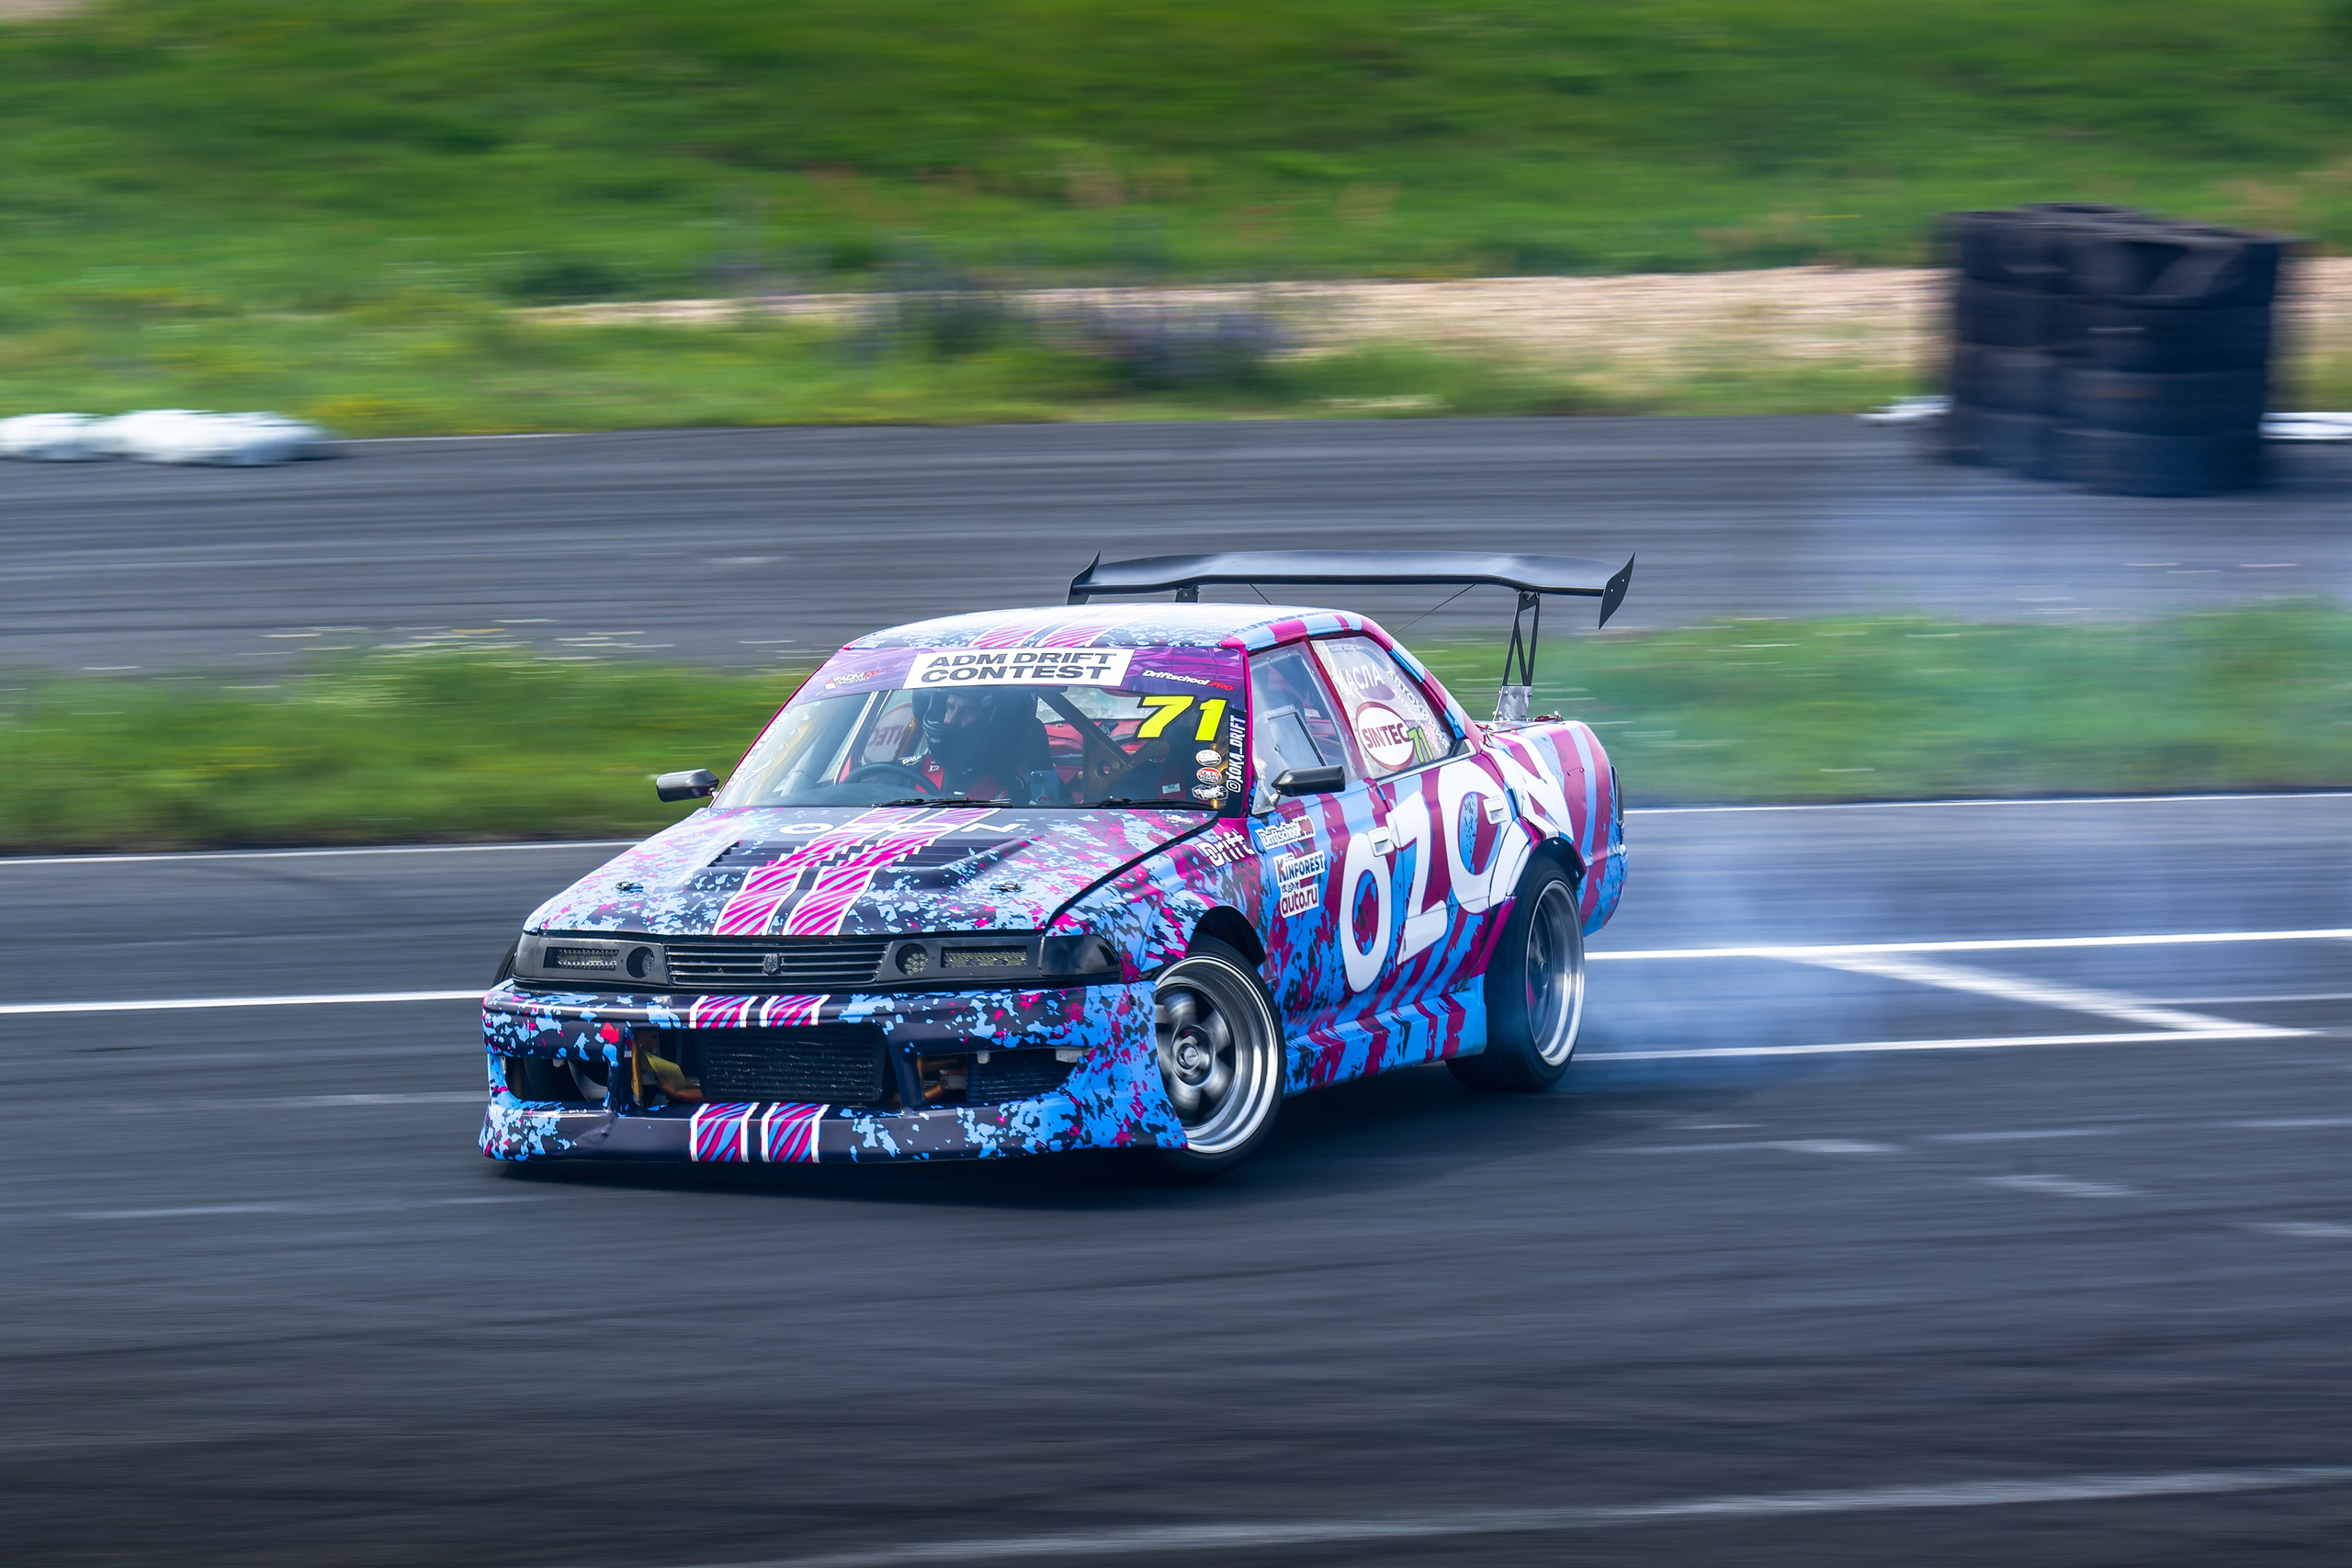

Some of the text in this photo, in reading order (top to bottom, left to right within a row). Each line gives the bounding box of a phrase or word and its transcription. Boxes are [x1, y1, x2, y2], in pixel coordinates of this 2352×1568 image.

[921, 665, 1112, 683] CONTEST
[927, 652, 1117, 669] ADM DRIFT
[1334, 662, 1385, 694] МАСЛА
[1136, 695, 1227, 741] 71
[1386, 669, 1452, 750] АВТОХИМИЯ
[1362, 722, 1413, 749] SINTEC
[1406, 726, 1434, 764] 71
[1196, 831, 1255, 866] Drift
[1340, 735, 1574, 993] OZON
[1276, 853, 1325, 883] KINFOREST
[1282, 887, 1317, 914] auto.ru
